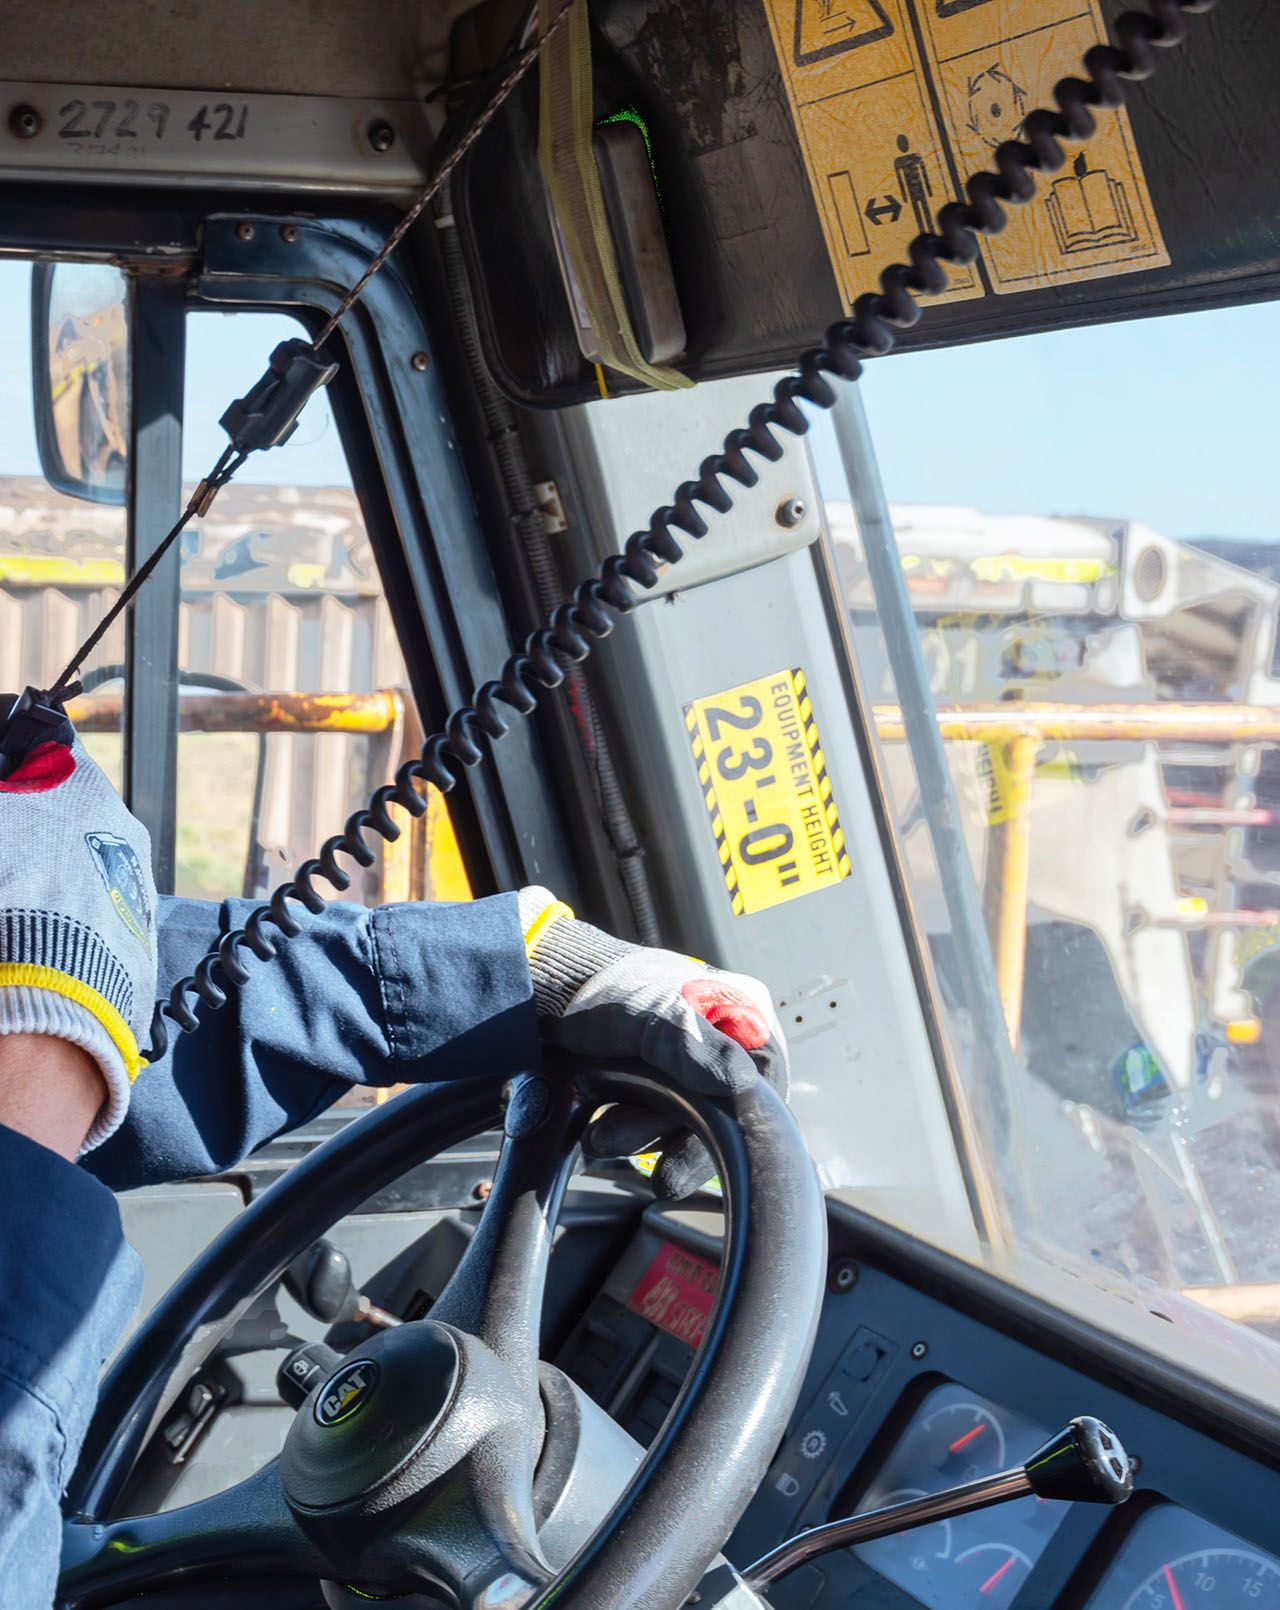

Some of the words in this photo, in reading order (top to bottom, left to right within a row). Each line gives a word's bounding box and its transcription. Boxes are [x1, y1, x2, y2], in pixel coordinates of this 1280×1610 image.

[58, 99, 170, 138] 2729
[187, 103, 248, 141] 421
[771, 682, 815, 797] EQUIPMENT
[800, 804, 834, 876] HEIGHT
[323, 1365, 368, 1418] CAT
[1194, 1572, 1217, 1592] 10
[1241, 1577, 1264, 1598] 15
